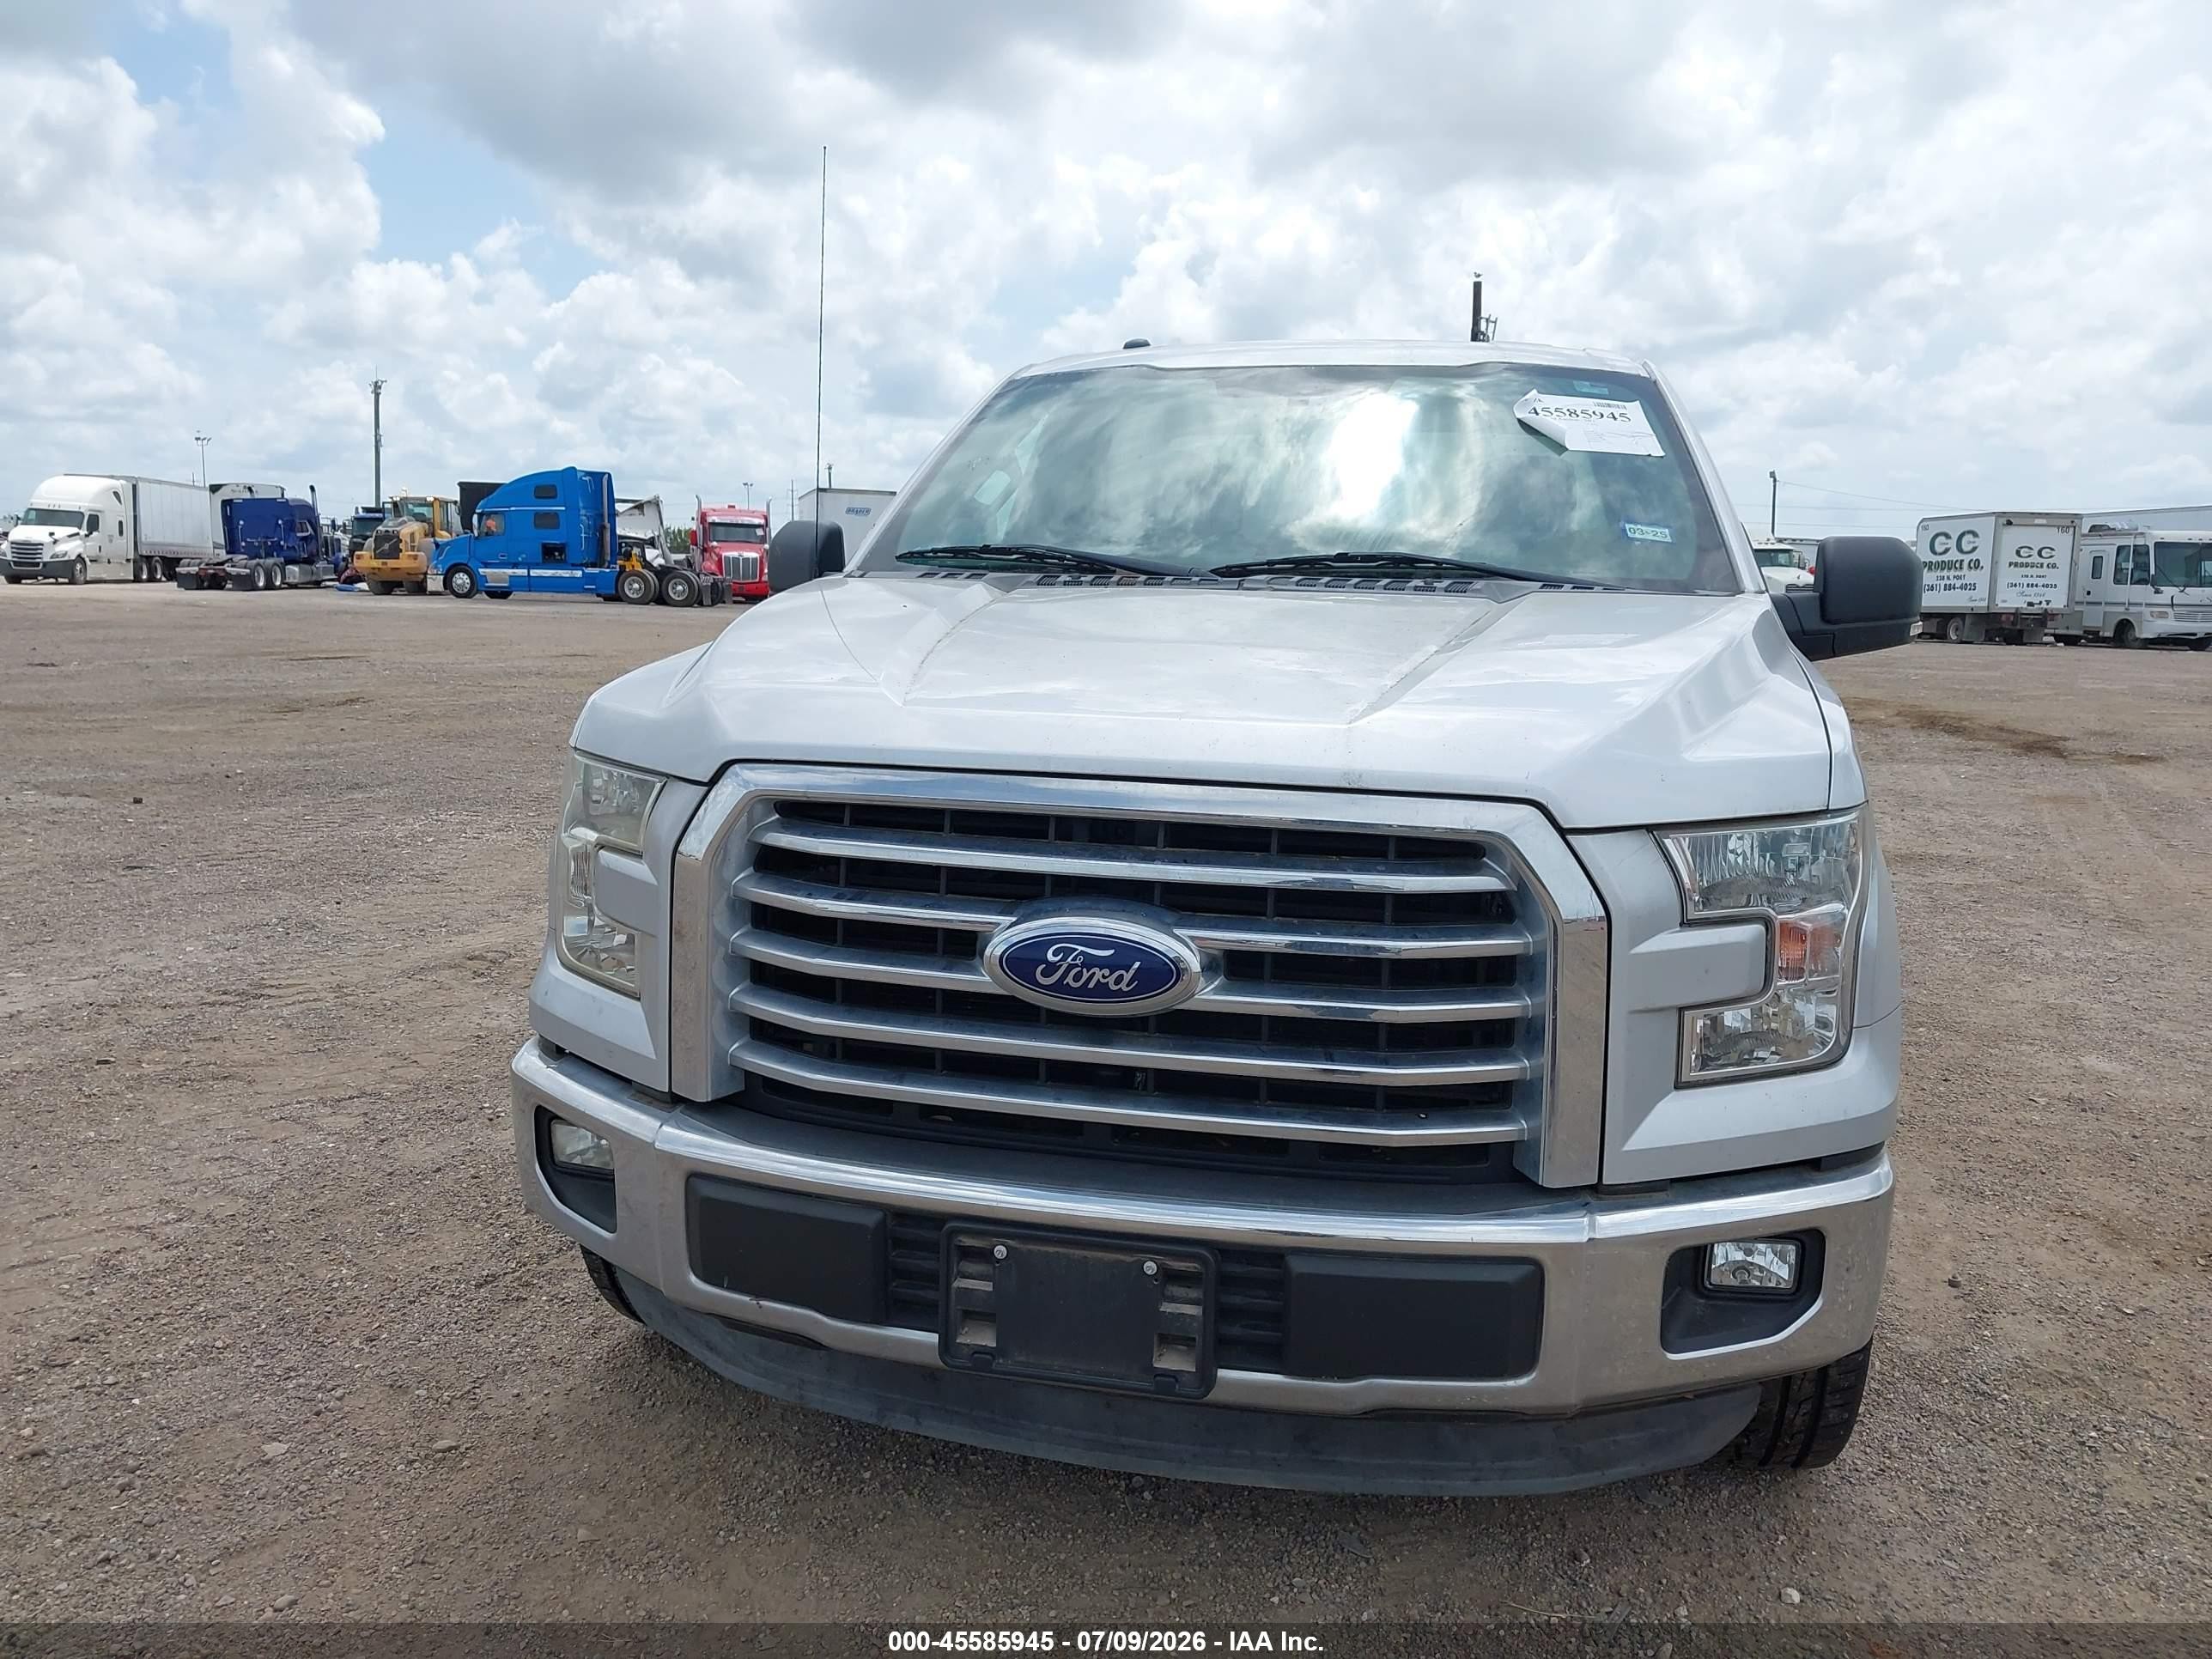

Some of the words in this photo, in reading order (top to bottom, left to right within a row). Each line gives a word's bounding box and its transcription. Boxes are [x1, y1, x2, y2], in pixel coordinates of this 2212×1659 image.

[1528, 406, 1632, 423] 45585945
[1923, 559, 1964, 572] PRODUCE
[1923, 583, 1941, 594] (361)
[1943, 583, 1977, 592] 884-4025
[1036, 943, 1141, 991] Ford
